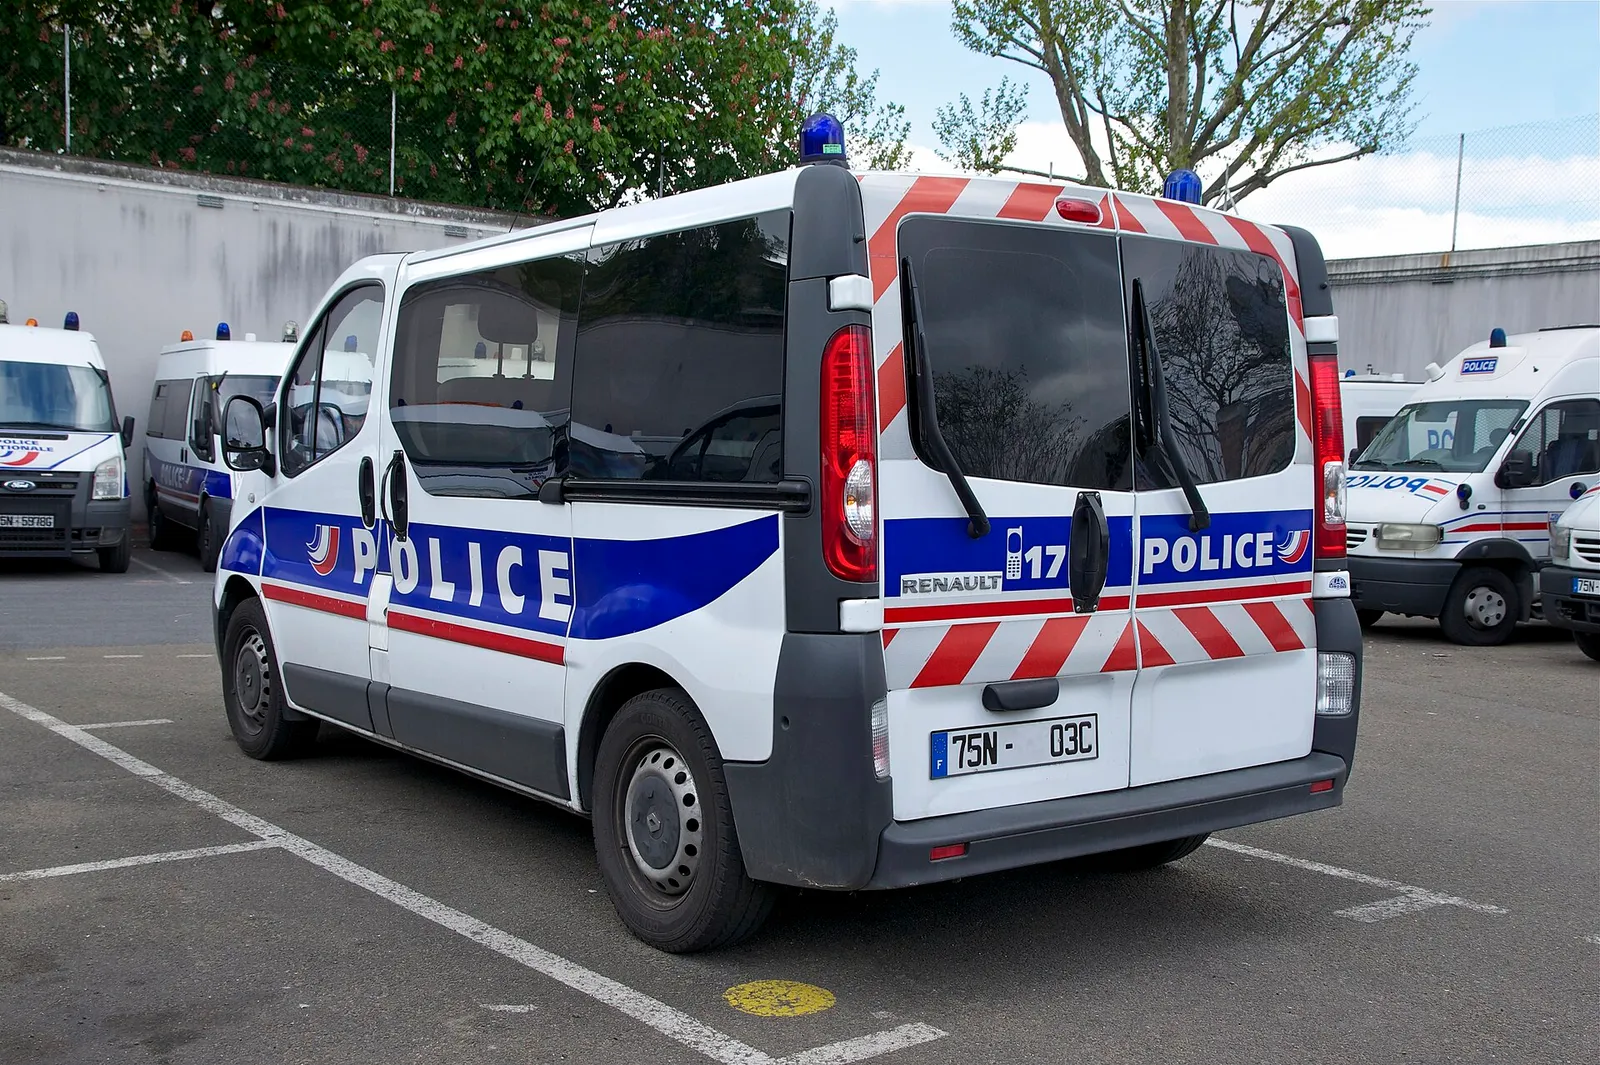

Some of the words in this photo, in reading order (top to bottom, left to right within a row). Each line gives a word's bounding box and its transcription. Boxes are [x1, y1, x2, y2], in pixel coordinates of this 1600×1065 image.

[1463, 361, 1496, 371] POLICE
[1024, 545, 1067, 579] 17
[1143, 531, 1274, 574] POLICE
[351, 527, 572, 623] POLICE
[902, 575, 1002, 594] RENAULT
[936, 759, 943, 770] F
